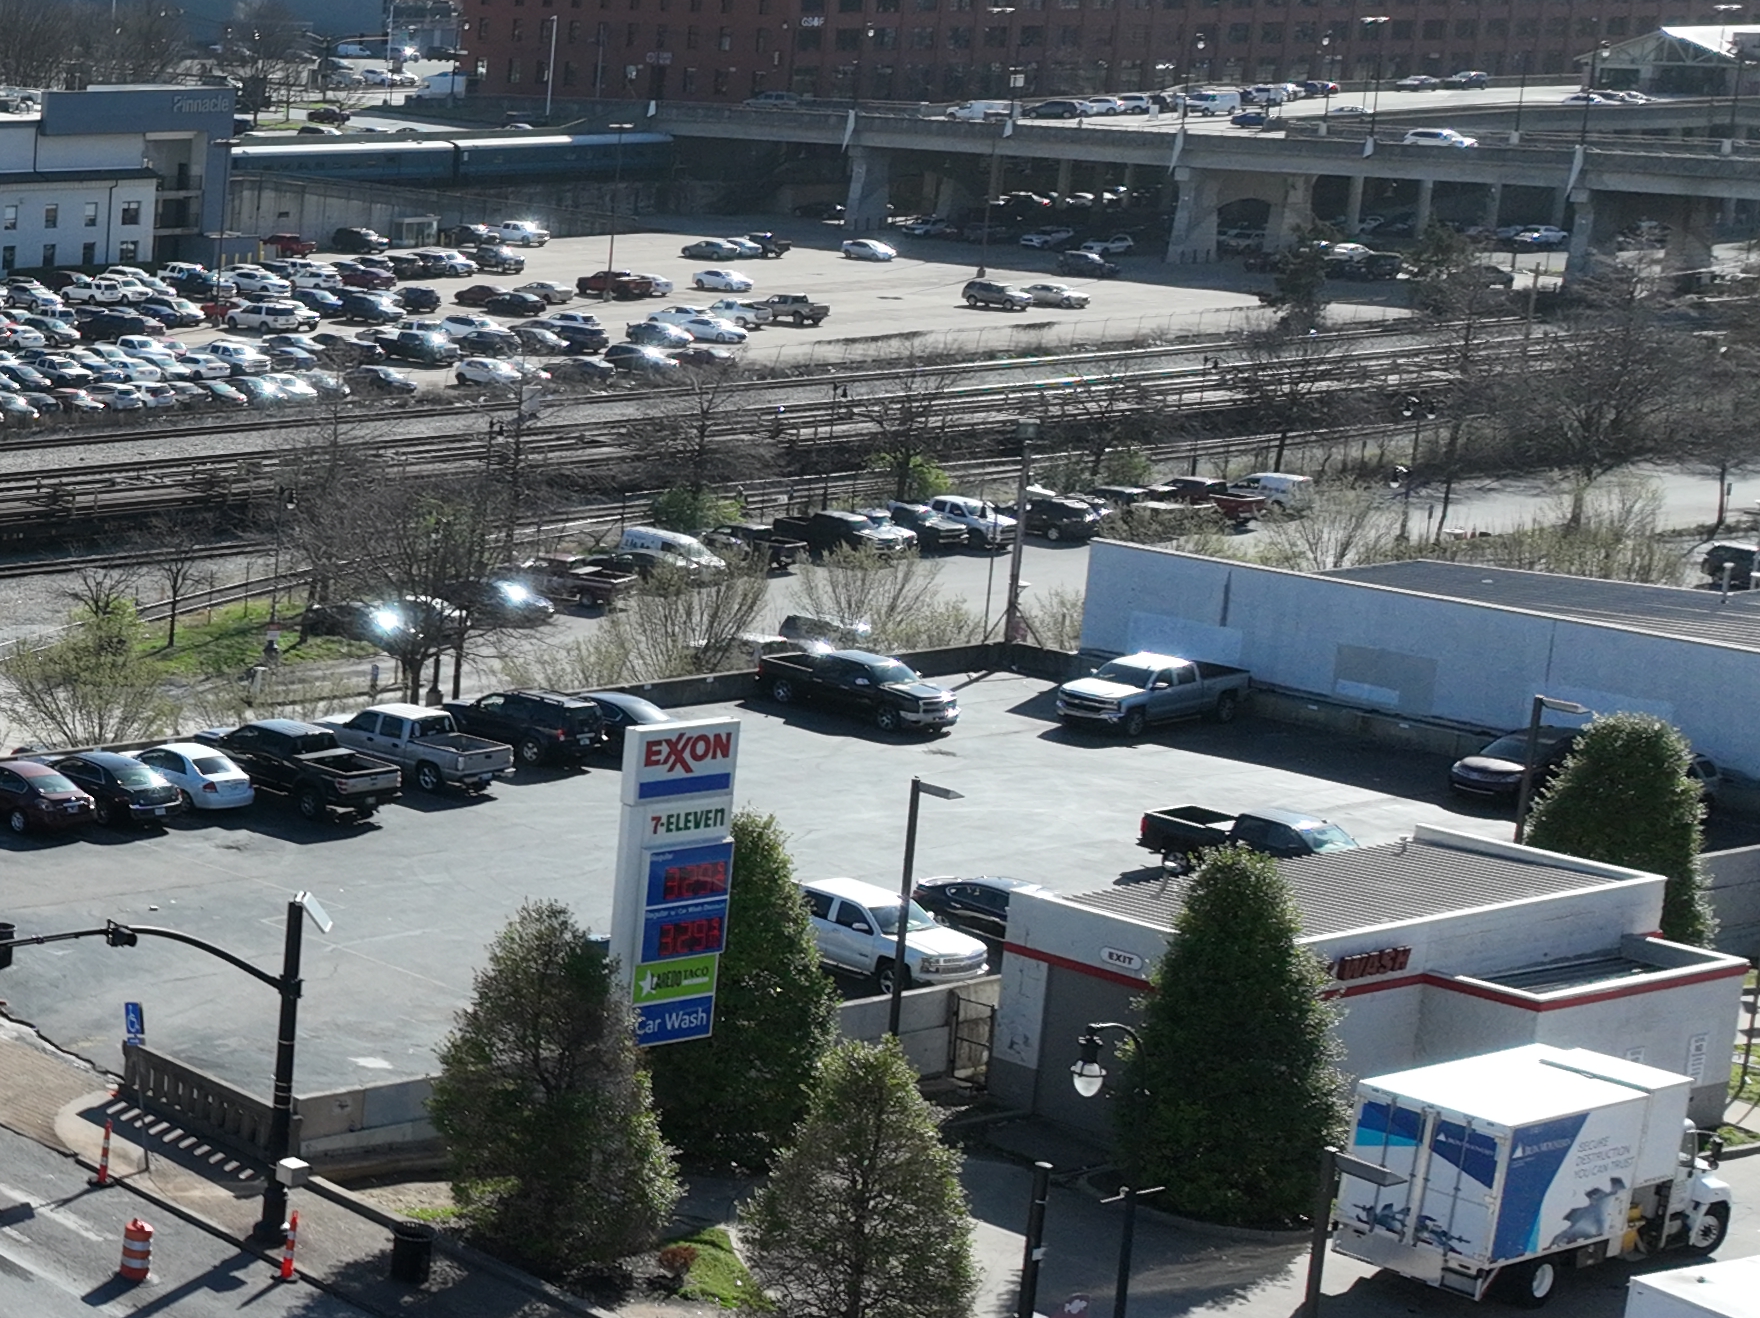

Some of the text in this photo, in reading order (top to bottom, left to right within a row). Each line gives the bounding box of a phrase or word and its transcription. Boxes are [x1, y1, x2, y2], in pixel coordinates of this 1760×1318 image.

[173, 94, 229, 113] Pinnacle
[644, 731, 733, 774] EXXON
[1108, 950, 1134, 966] EXIT
[665, 1006, 707, 1031] Wash
